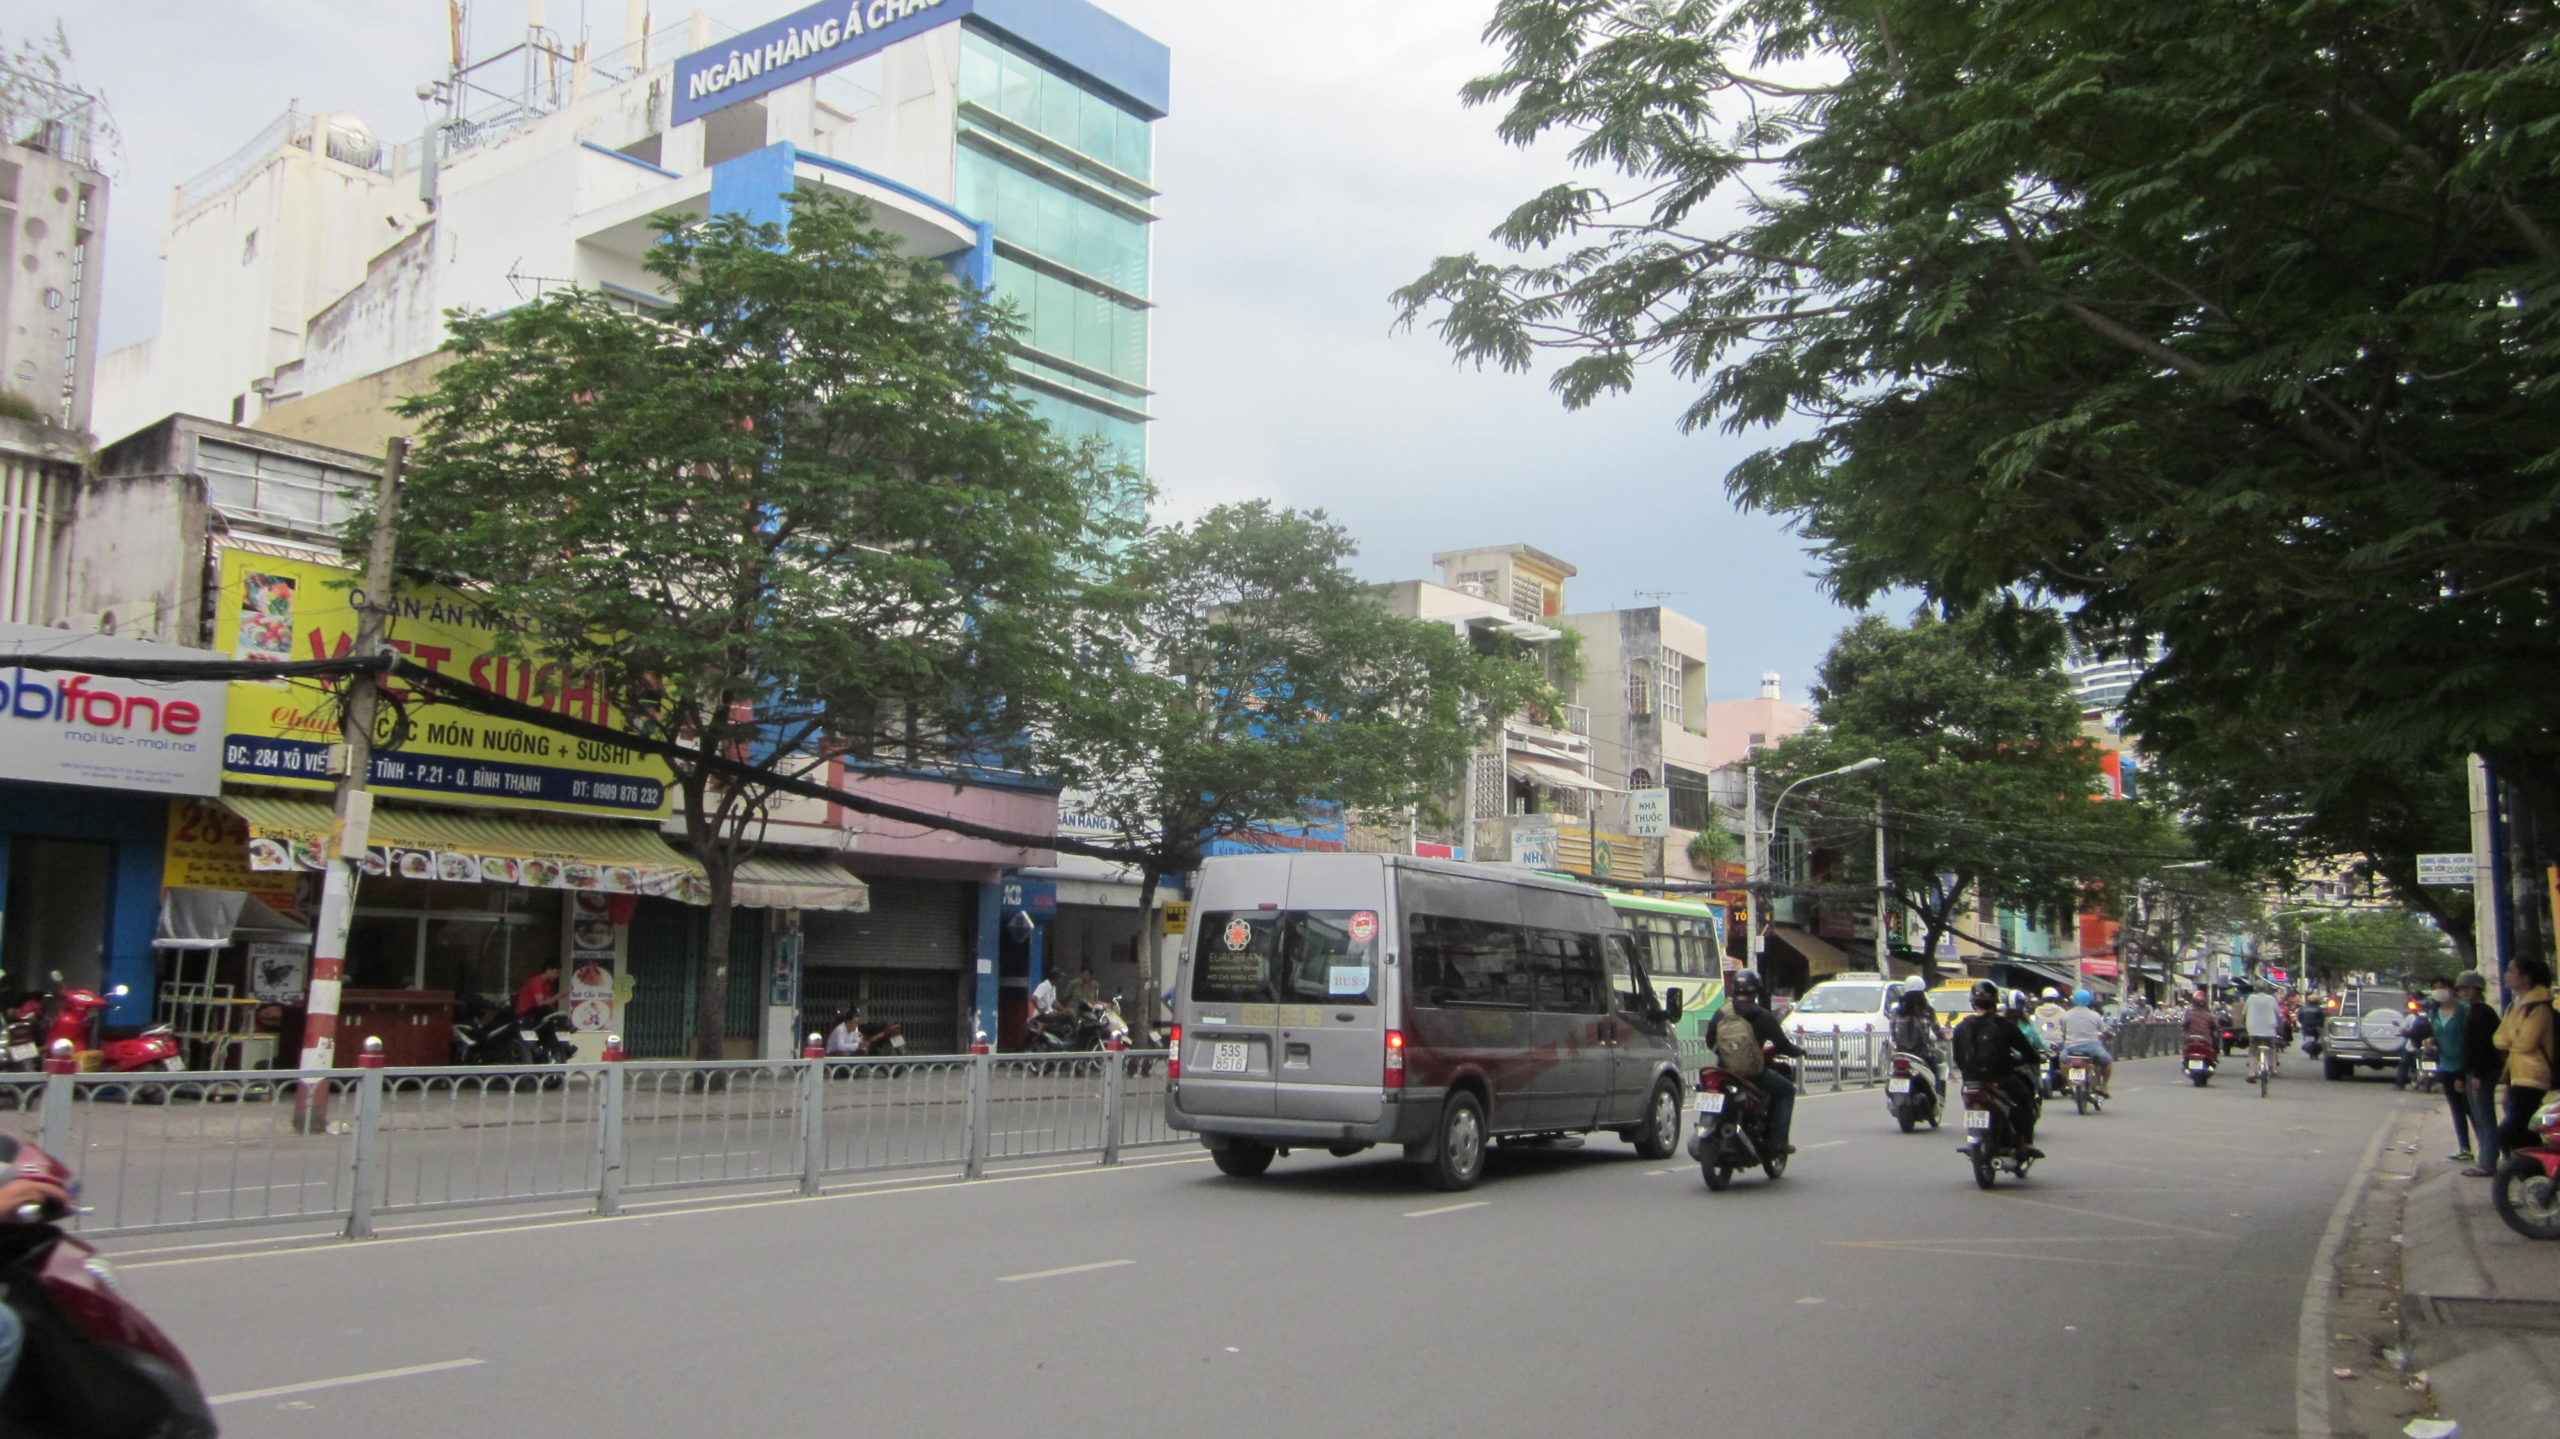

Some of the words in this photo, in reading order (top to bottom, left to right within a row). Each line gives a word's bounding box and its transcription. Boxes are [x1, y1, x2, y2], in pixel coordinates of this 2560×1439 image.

[689, 49, 762, 99] NGÂN
[765, 18, 841, 71] HÀNG
[842, 2, 864, 40] Á
[429, 597, 464, 626] ĂN
[469, 654, 609, 729] SUSHI
[427, 721, 474, 748] MÓN
[483, 729, 550, 757] NƯỚNG
[576, 740, 630, 765] SUSHI
[227, 745, 250, 765] ĐC:
[254, 749, 279, 768] 284
[283, 747, 301, 769] XÔ
[305, 750, 328, 773] VIẾ
[376, 757, 404, 780] TĨNH
[417, 764, 444, 784] P.21
[473, 767, 501, 789] BÌNH
[504, 772, 542, 794] THẠNH
[592, 783, 618, 801] 0909
[620, 786, 638, 802] 876
[640, 788, 659, 804] 232
[1634, 812, 1664, 823] THUỐC
[1638, 825, 1658, 835] TÂY
[1335, 976, 1358, 987] BUS
[1220, 1044, 1241, 1058] 53S
[1215, 1057, 1243, 1070] 8516
